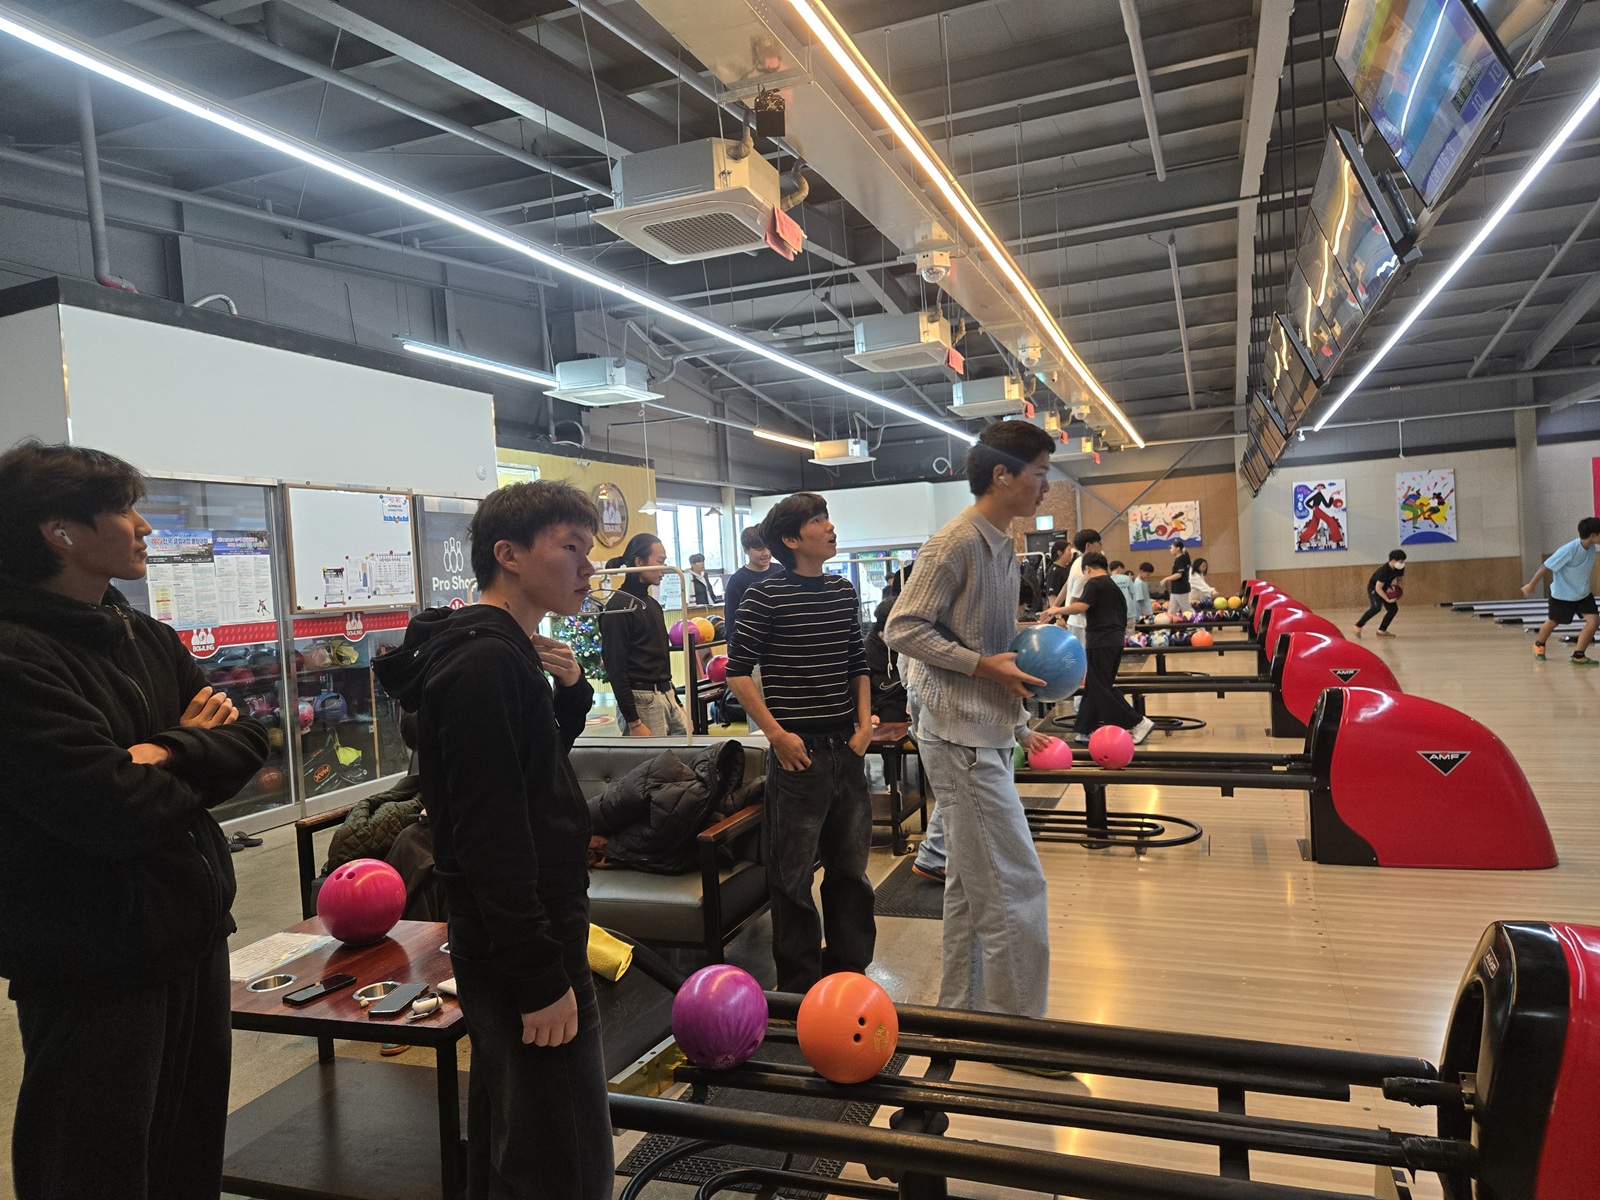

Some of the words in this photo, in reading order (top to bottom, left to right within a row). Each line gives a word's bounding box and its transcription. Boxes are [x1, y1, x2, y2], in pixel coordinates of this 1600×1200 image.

[432, 576, 450, 591] Pro
[192, 643, 215, 653] BOWLING
[1485, 953, 1497, 972] AMF
